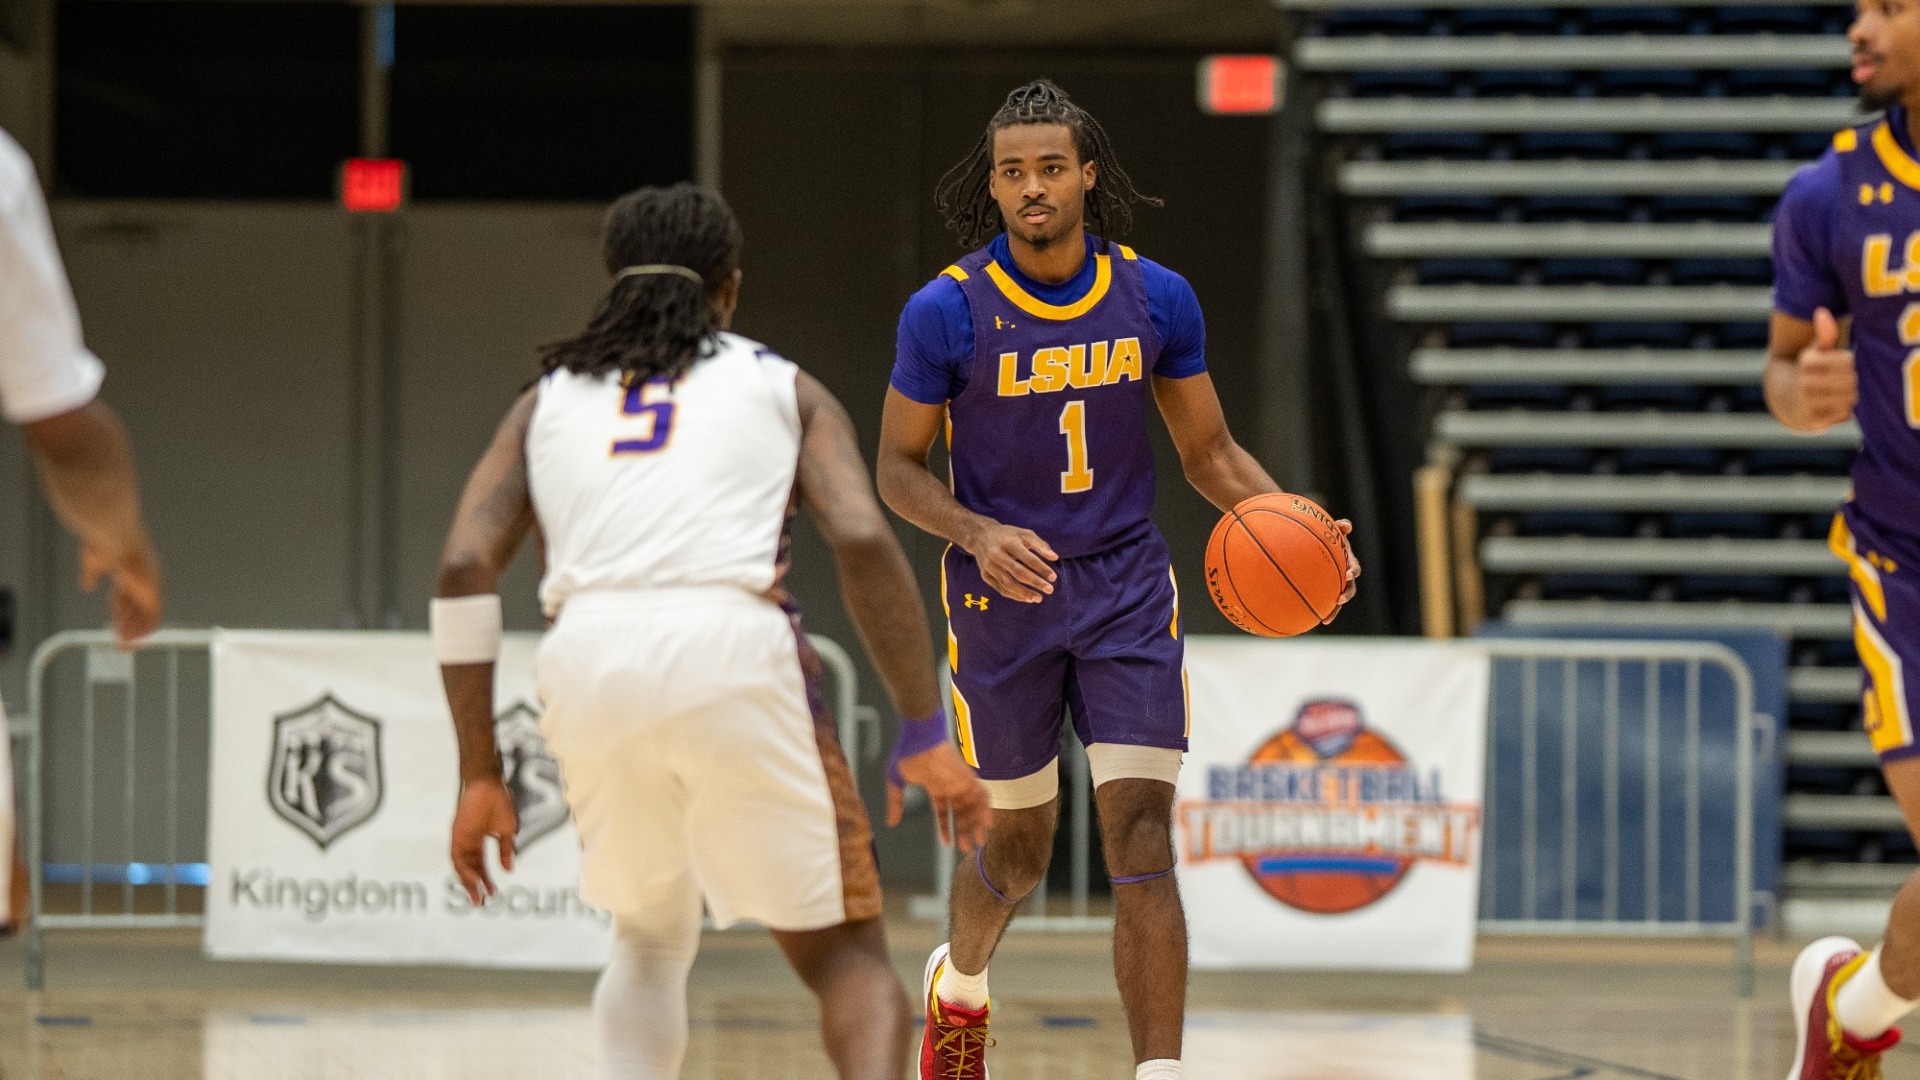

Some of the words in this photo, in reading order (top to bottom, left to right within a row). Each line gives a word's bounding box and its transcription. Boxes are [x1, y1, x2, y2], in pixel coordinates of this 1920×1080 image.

[998, 337, 1142, 397] LSUA
[1059, 400, 1094, 493] 1
[1208, 765, 1448, 804] BASKETBALL
[1178, 800, 1480, 867] TOURNAMENT
[231, 867, 428, 922] Kingdom
